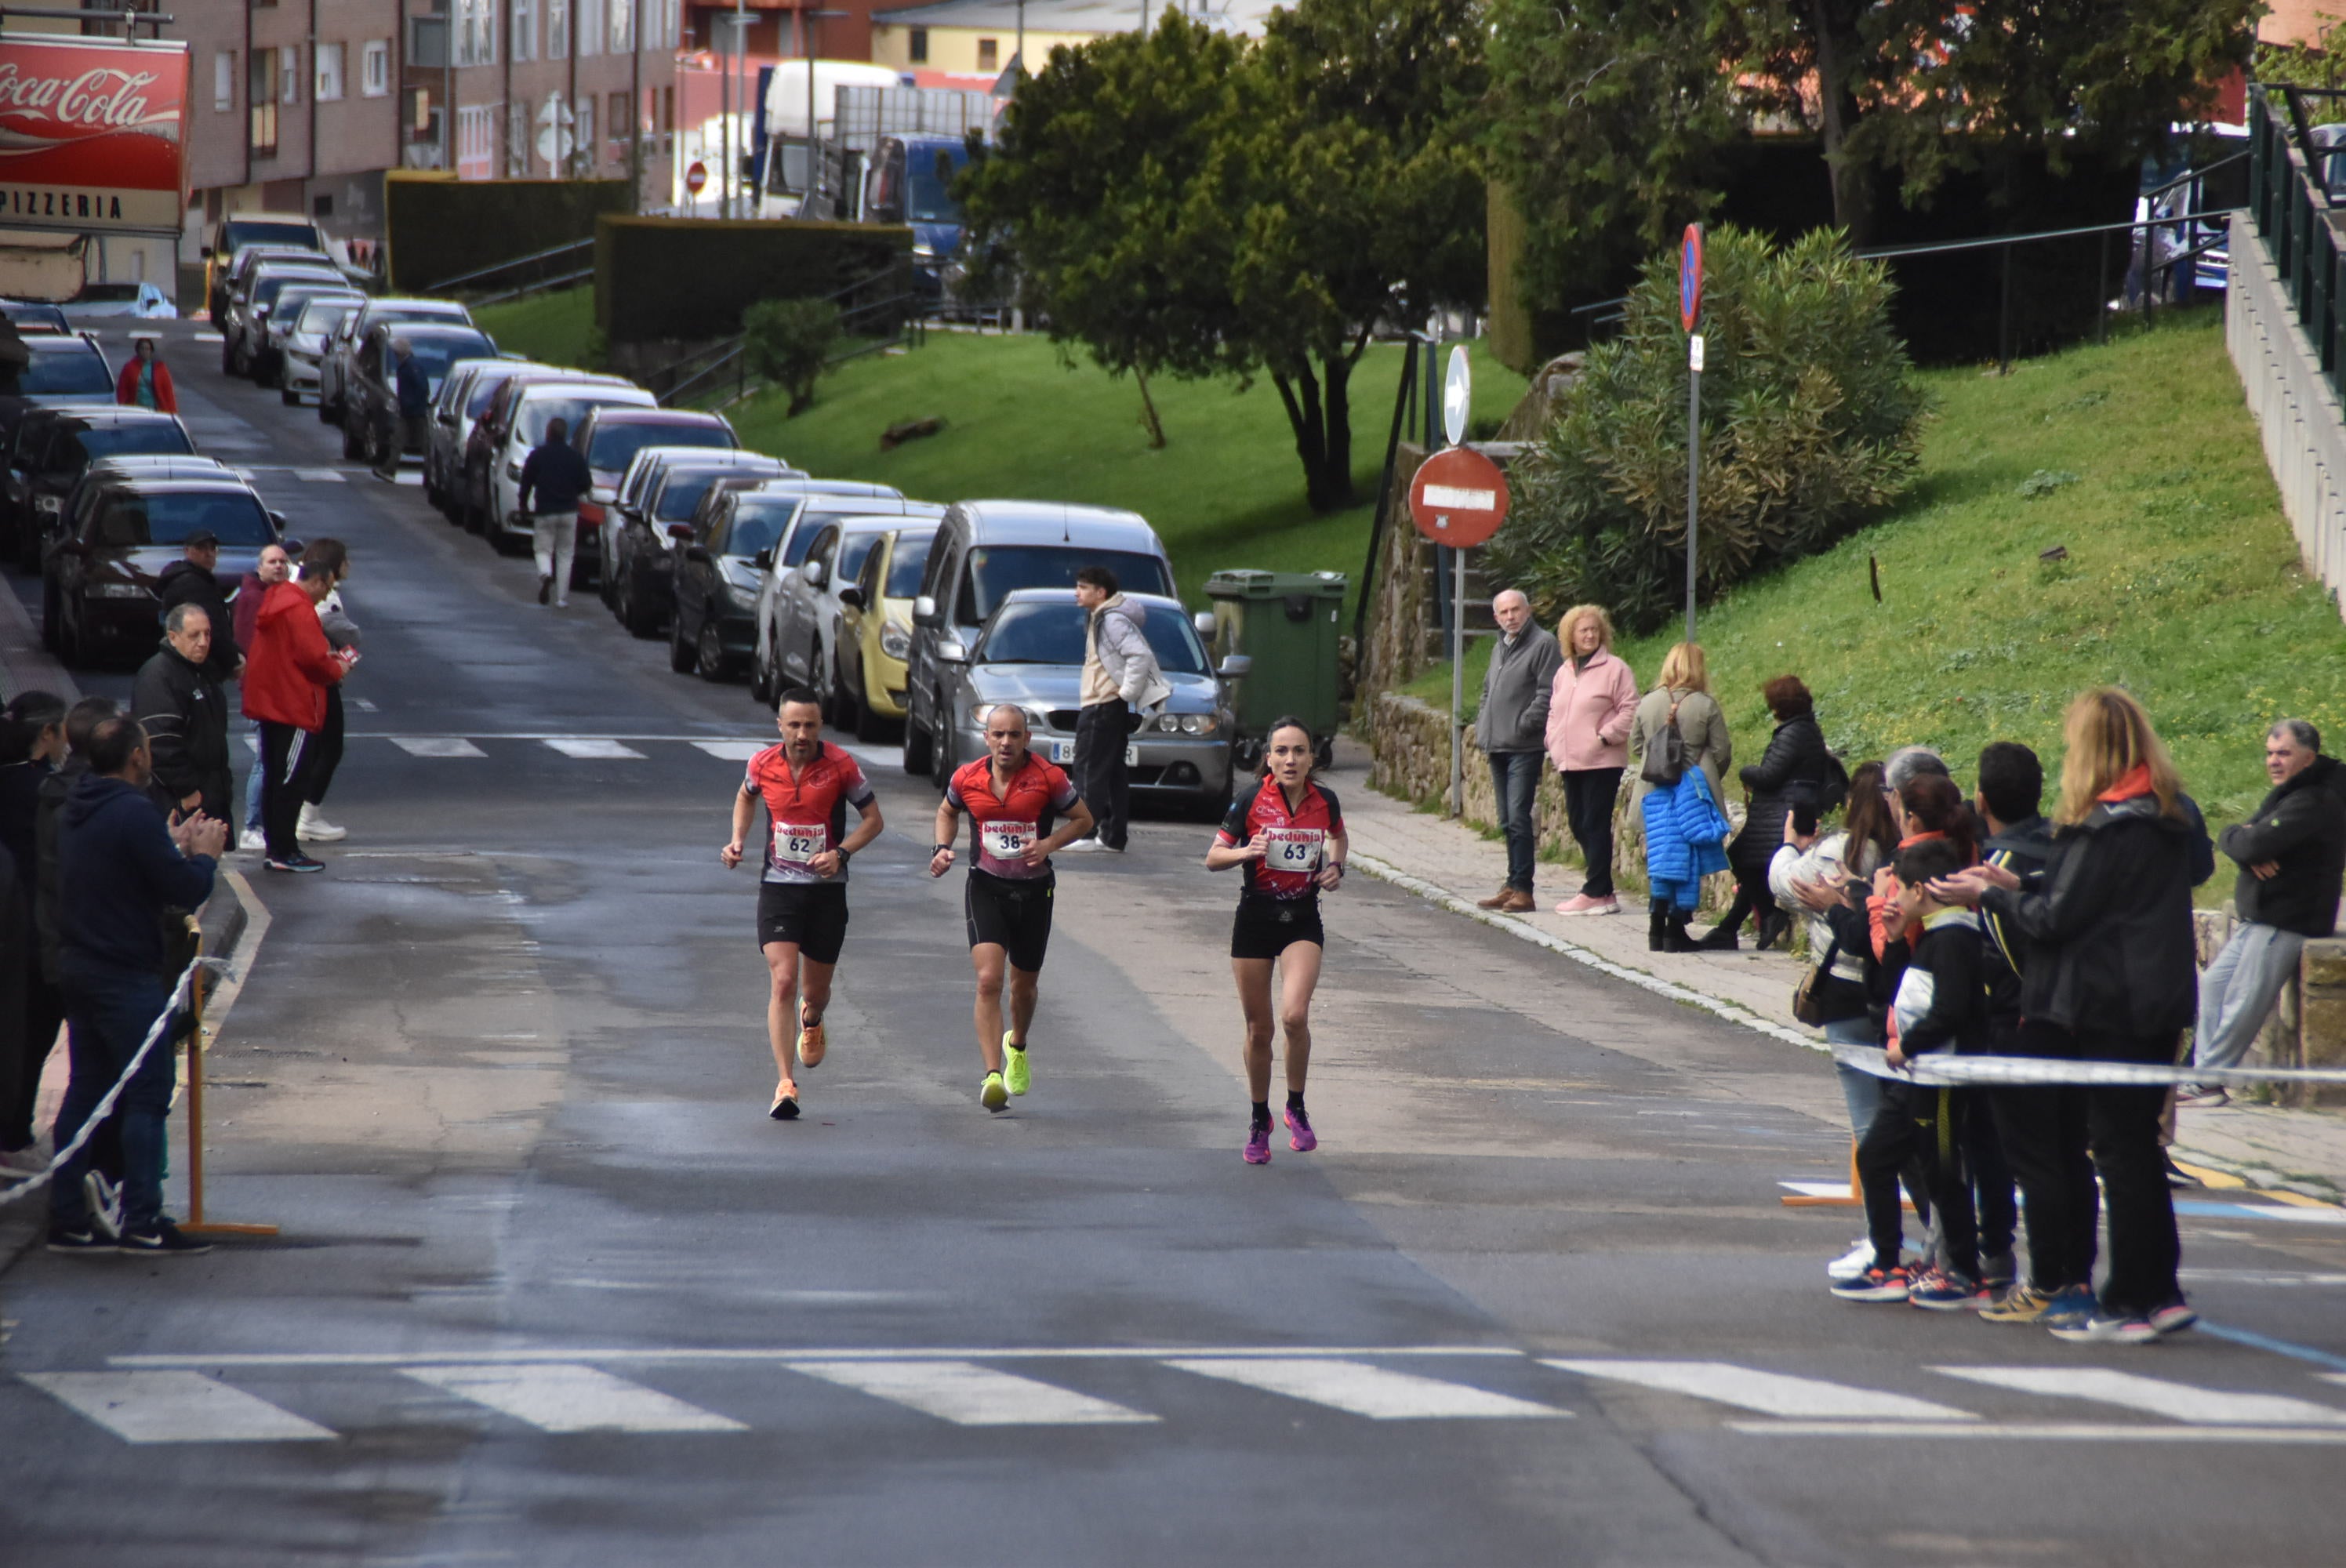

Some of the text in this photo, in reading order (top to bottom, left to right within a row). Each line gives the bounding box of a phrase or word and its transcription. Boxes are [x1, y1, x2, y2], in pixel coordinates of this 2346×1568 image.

[0, 191, 121, 219] PIZZERIA
[790, 837, 810, 853] 62
[1000, 835, 1020, 849] 38
[1268, 831, 1320, 843] bedunia
[1284, 844, 1306, 860] 63
